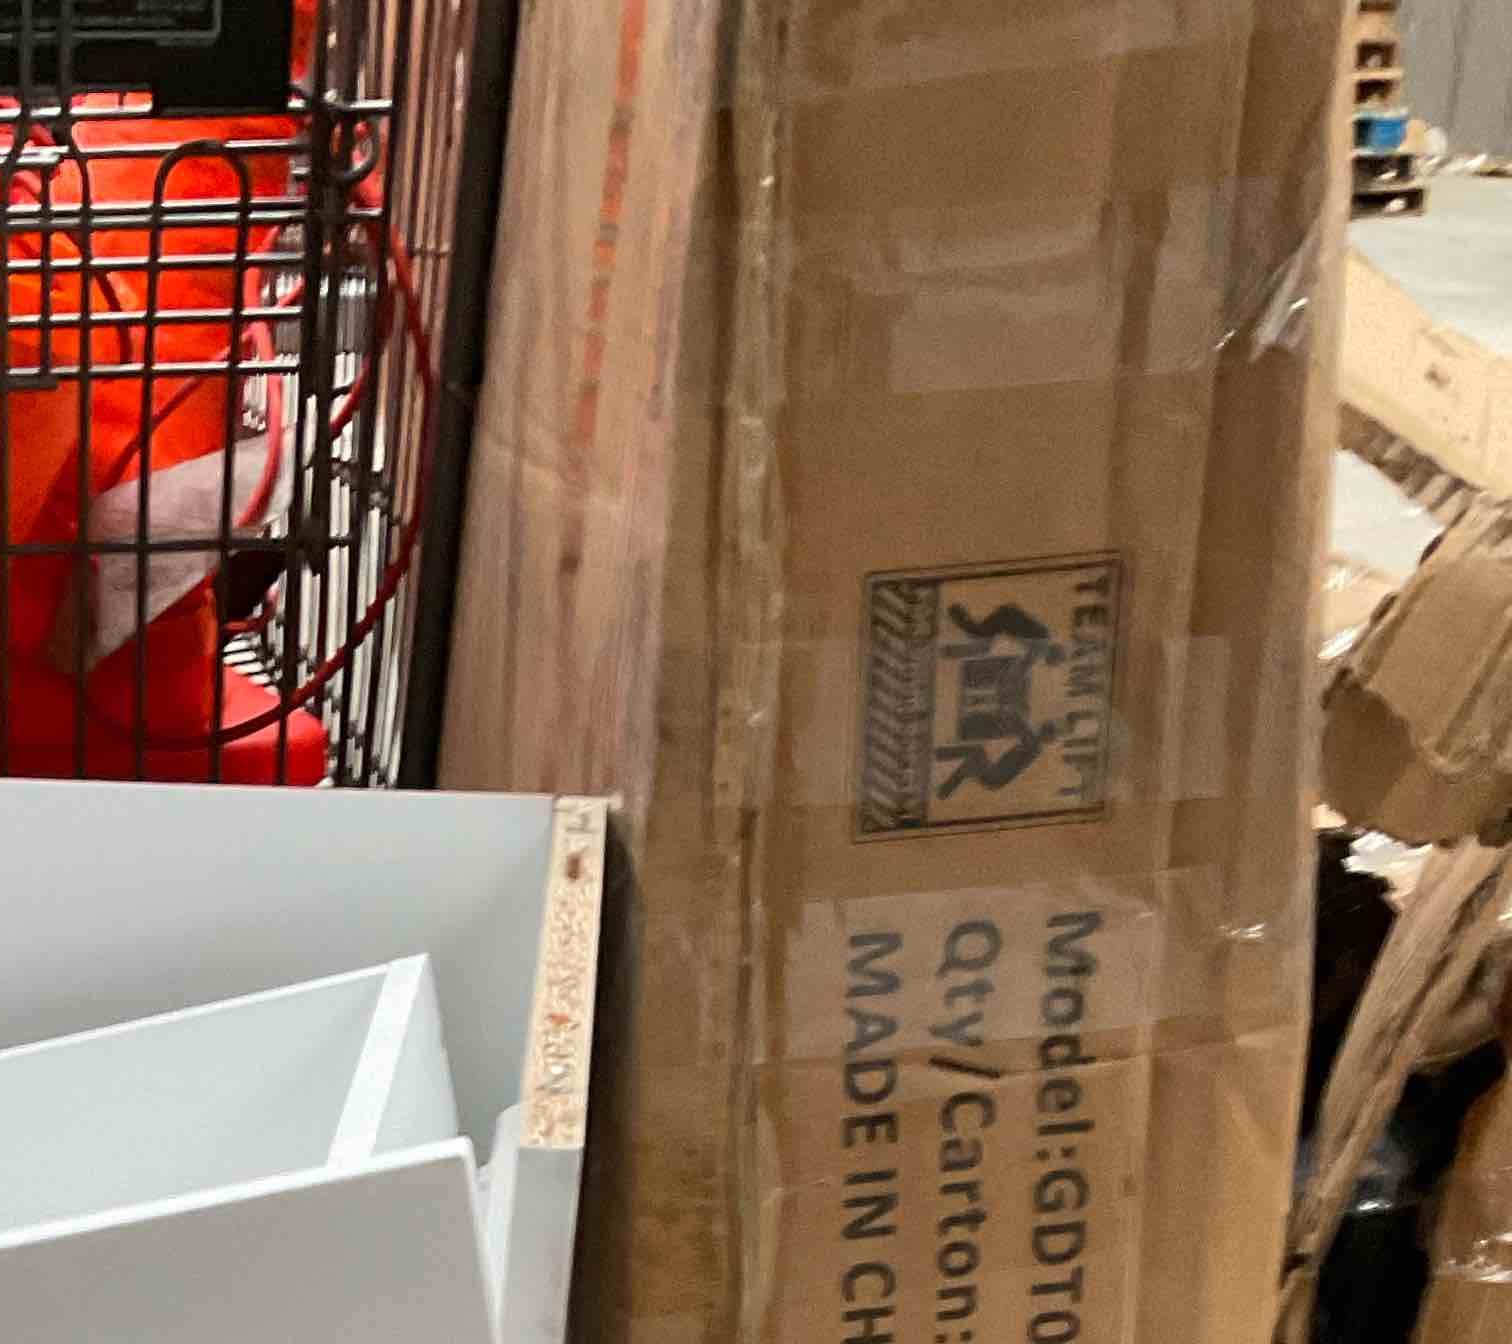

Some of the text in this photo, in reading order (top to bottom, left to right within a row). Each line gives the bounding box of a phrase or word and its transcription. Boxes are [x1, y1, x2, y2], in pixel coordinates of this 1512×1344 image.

[1060, 575, 1112, 806] TEAM LIFT
[842, 931, 903, 1147] MADE
[928, 920, 1003, 1344] Qty/Carton:
[842, 1172, 898, 1241] IN
